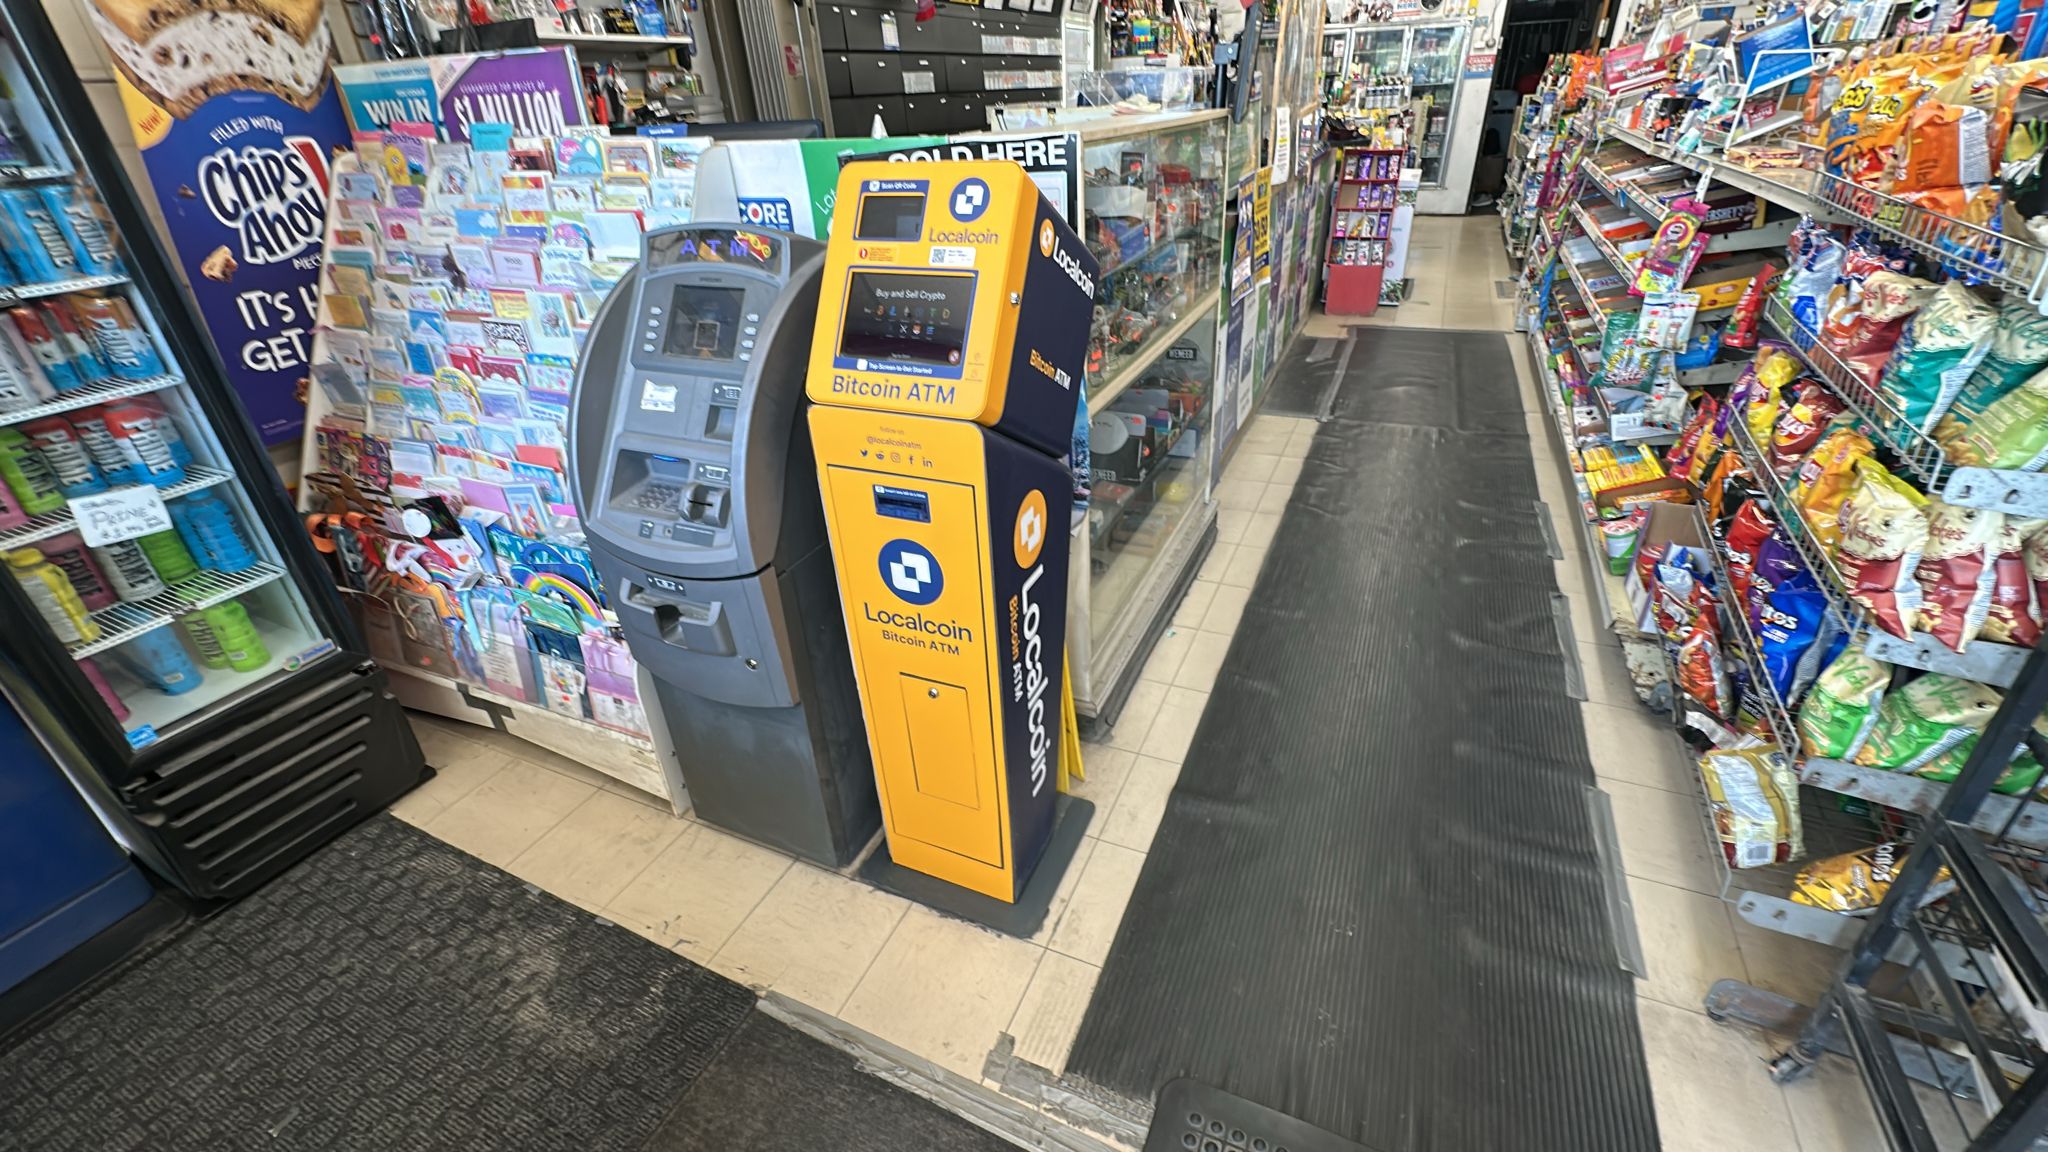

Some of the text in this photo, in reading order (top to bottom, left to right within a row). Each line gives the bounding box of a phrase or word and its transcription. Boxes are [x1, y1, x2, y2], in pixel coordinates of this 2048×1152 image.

[210, 115, 284, 145] FILLED WITH
[363, 96, 433, 126] WIN IN
[478, 88, 566, 137] MILLION
[981, 138, 1068, 166] HERE
[204, 149, 308, 222] Chips
[681, 239, 748, 257] ATM
[929, 228, 999, 245] Localcoin
[1053, 236, 1095, 300] Localcoin
[236, 290, 296, 331] IT'S
[876, 288, 946, 302] Buy and Sell Crypto
[242, 327, 308, 373] GET
[1029, 348, 1071, 391] Bitcoin ATM
[833, 375, 956, 405] Bitcoin ATM
[33, 429, 95, 486] PRIME
[121, 417, 178, 475] PRIME
[864, 602, 973, 642] Localcoin
[882, 629, 960, 656] Bitcoin ATM
[1009, 594, 1024, 703] Bitcoin ATM
[1021, 563, 1050, 798] Localcoin
